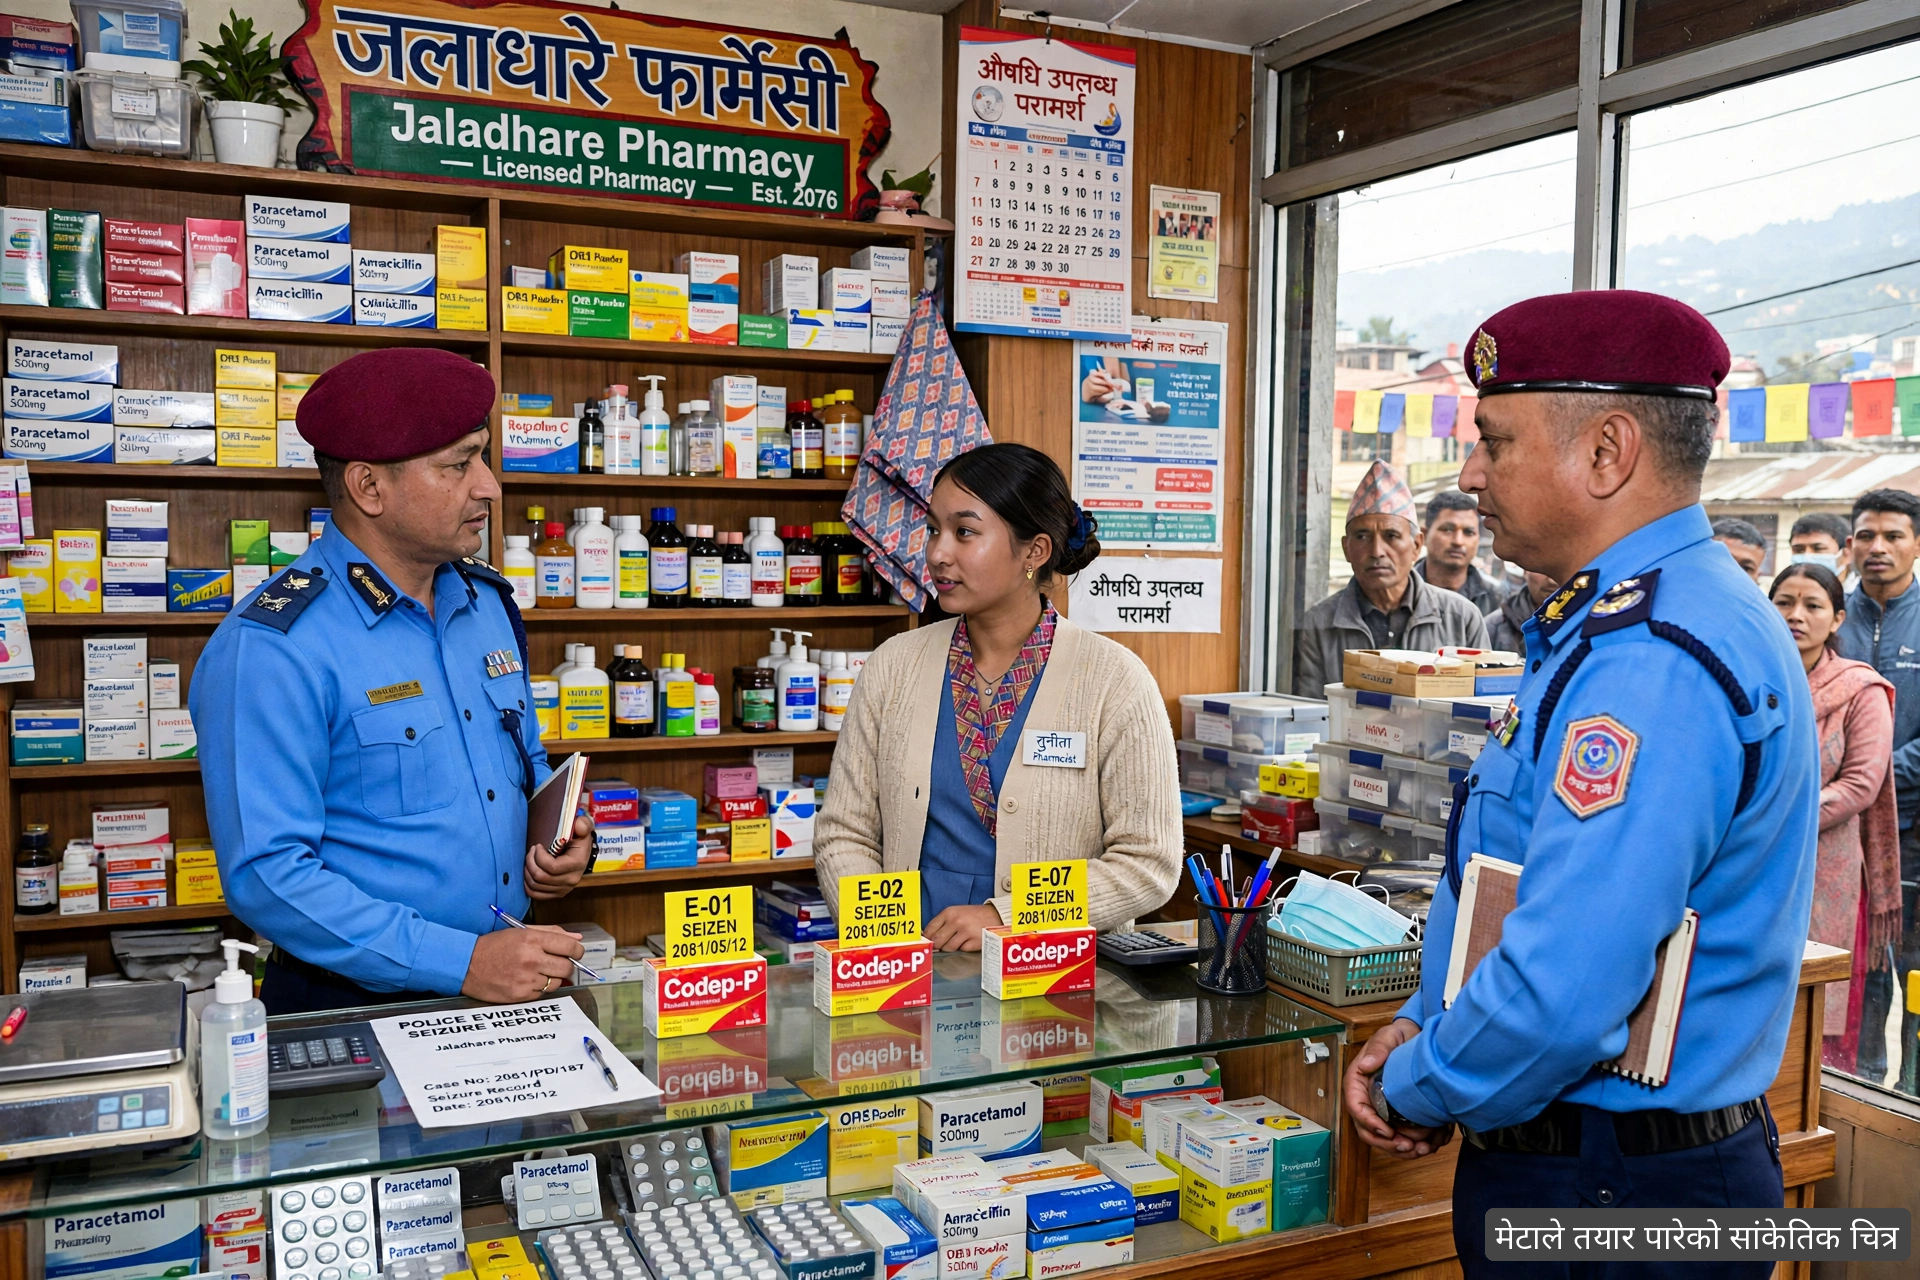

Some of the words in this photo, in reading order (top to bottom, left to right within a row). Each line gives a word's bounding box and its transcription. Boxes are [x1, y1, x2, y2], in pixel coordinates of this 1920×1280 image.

[333, 5, 615, 108] जलाधारे
[626, 35, 848, 134] फार्मेसी
[391, 102, 604, 160] Jaladhare
[619, 127, 815, 187] Pharmacy
[482, 155, 583, 185] Licensed
[589, 167, 696, 199] Pharmacy
[994, 160, 998, 170] 1
[1010, 162, 1016, 171] 2
[1027, 164, 1033, 173] 3
[1061, 168, 1068, 177] 5
[1078, 169, 1084, 178] 4
[1095, 171, 1101, 180] 5
[1112, 173, 1119, 182] 6
[752, 182, 788, 206] Est.
[793, 184, 838, 210] 2076
[975, 177, 980, 187] 7
[993, 179, 999, 189] 8
[1010, 181, 1016, 191] 9
[1027, 183, 1033, 193] 9
[1044, 185, 1051, 195] 8
[1063, 187, 1068, 196] 9
[1076, 188, 1086, 198] 10
[1093, 191, 1102, 201] 11
[252, 203, 327, 219] Paracetamol
[972, 197, 982, 207] 11
[991, 198, 1001, 209] 13
[1008, 200, 1018, 210] 13
[1025, 202, 1036, 212] 14
[1043, 204, 1053, 214] 15
[1060, 206, 1070, 216] 16
[1076, 208, 1086, 218] 16
[990, 218, 1000, 228] 15
[1008, 220, 1018, 230] 16
[1042, 223, 1053, 233] 22
[1059, 225, 1070, 235] 22
[254, 244, 329, 260] Paracetamol
[1007, 240, 1019, 249] 29
[1042, 243, 1053, 253] 22
[1075, 246, 1086, 255] 27
[989, 257, 1000, 267] 27
[1007, 259, 1018, 269] 28
[1058, 263, 1070, 273] 30
[14, 345, 93, 361] Paracetamol
[10, 385, 90, 401] Paracetamol
[10, 426, 90, 440] Paracetamol
[1029, 866, 1072, 888] E-07
[858, 879, 903, 901] E-02
[1026, 889, 1074, 906] SEIZEN
[685, 893, 732, 918] E-01
[854, 902, 906, 920] SEIZEN
[1017, 906, 1083, 925] 2081/05/12
[682, 919, 737, 937] SEIZEN
[846, 920, 915, 940] 2081/05/12
[672, 937, 747, 958] 2081/05/12
[1007, 936, 1091, 964] Codep-P
[837, 951, 926, 980] Codep-P
[664, 968, 760, 999] Codep-P
[398, 1016, 466, 1030] POLICE
[471, 1004, 562, 1020] EVIDENCE
[408, 1023, 486, 1038] SEIZURE
[492, 1014, 563, 1028] REPORT
[435, 1039, 495, 1052] Jaladhare
[497, 1032, 556, 1045] Pharmacy
[424, 1081, 460, 1091] Case
[464, 1076, 490, 1086] No:
[432, 1102, 471, 1113] Date:
[939, 1101, 1026, 1129] Paracetamol
[520, 1160, 589, 1179] Paracetamol
[384, 1174, 452, 1194] Paracetamol
[54, 1204, 166, 1233] Paracetamol
[386, 1211, 453, 1232] Paracetamol
[389, 1238, 457, 1260] Paracetamol
